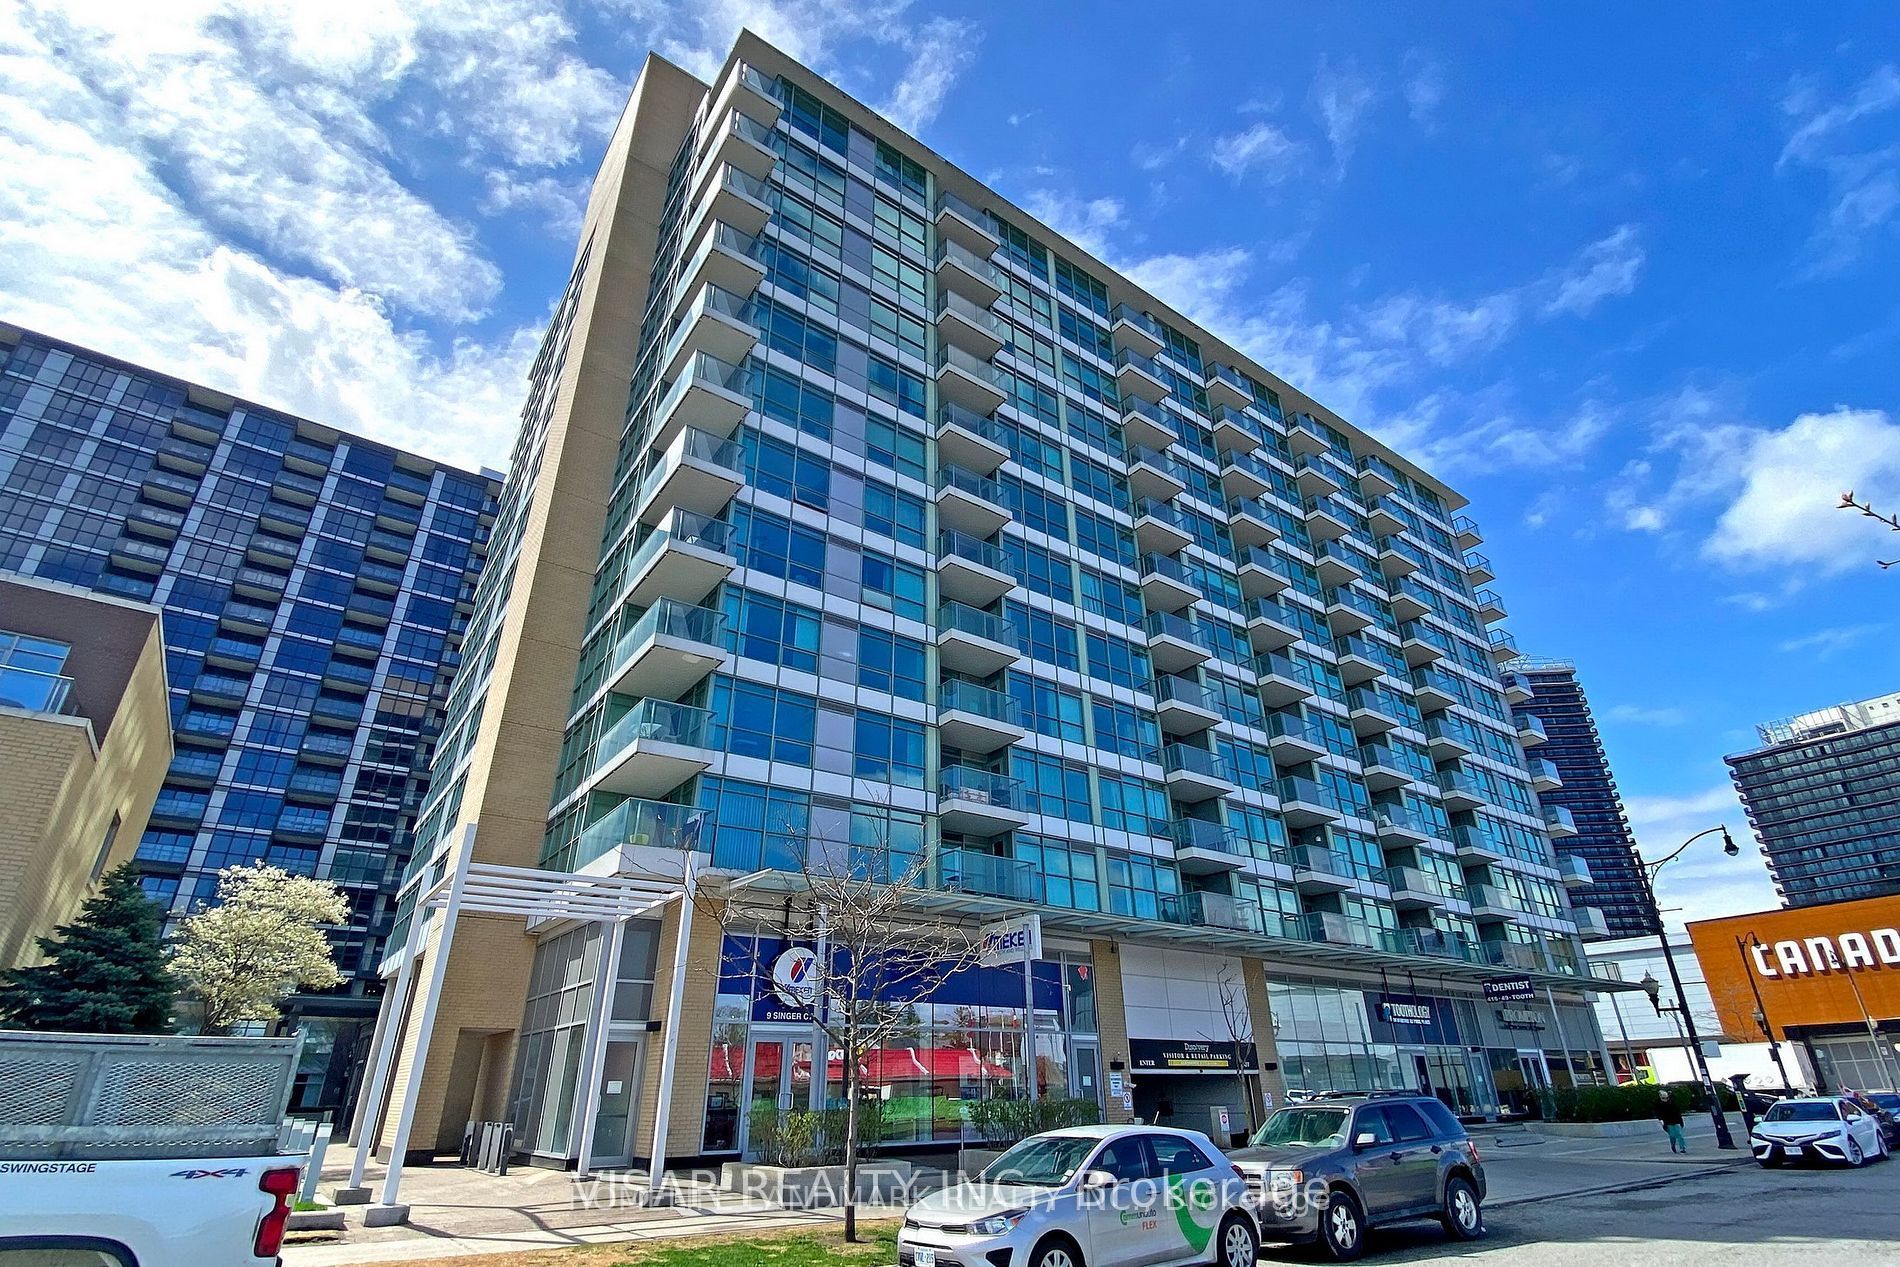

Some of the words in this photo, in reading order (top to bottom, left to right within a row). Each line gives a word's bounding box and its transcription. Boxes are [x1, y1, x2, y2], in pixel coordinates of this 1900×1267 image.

[1492, 981, 1530, 992] DENTIST
[766, 1012, 772, 1020] 9
[773, 1012, 802, 1020] SINGER
[0, 1163, 97, 1173] SWINGSTAGE
[1142, 1220, 1158, 1231] FLEX
